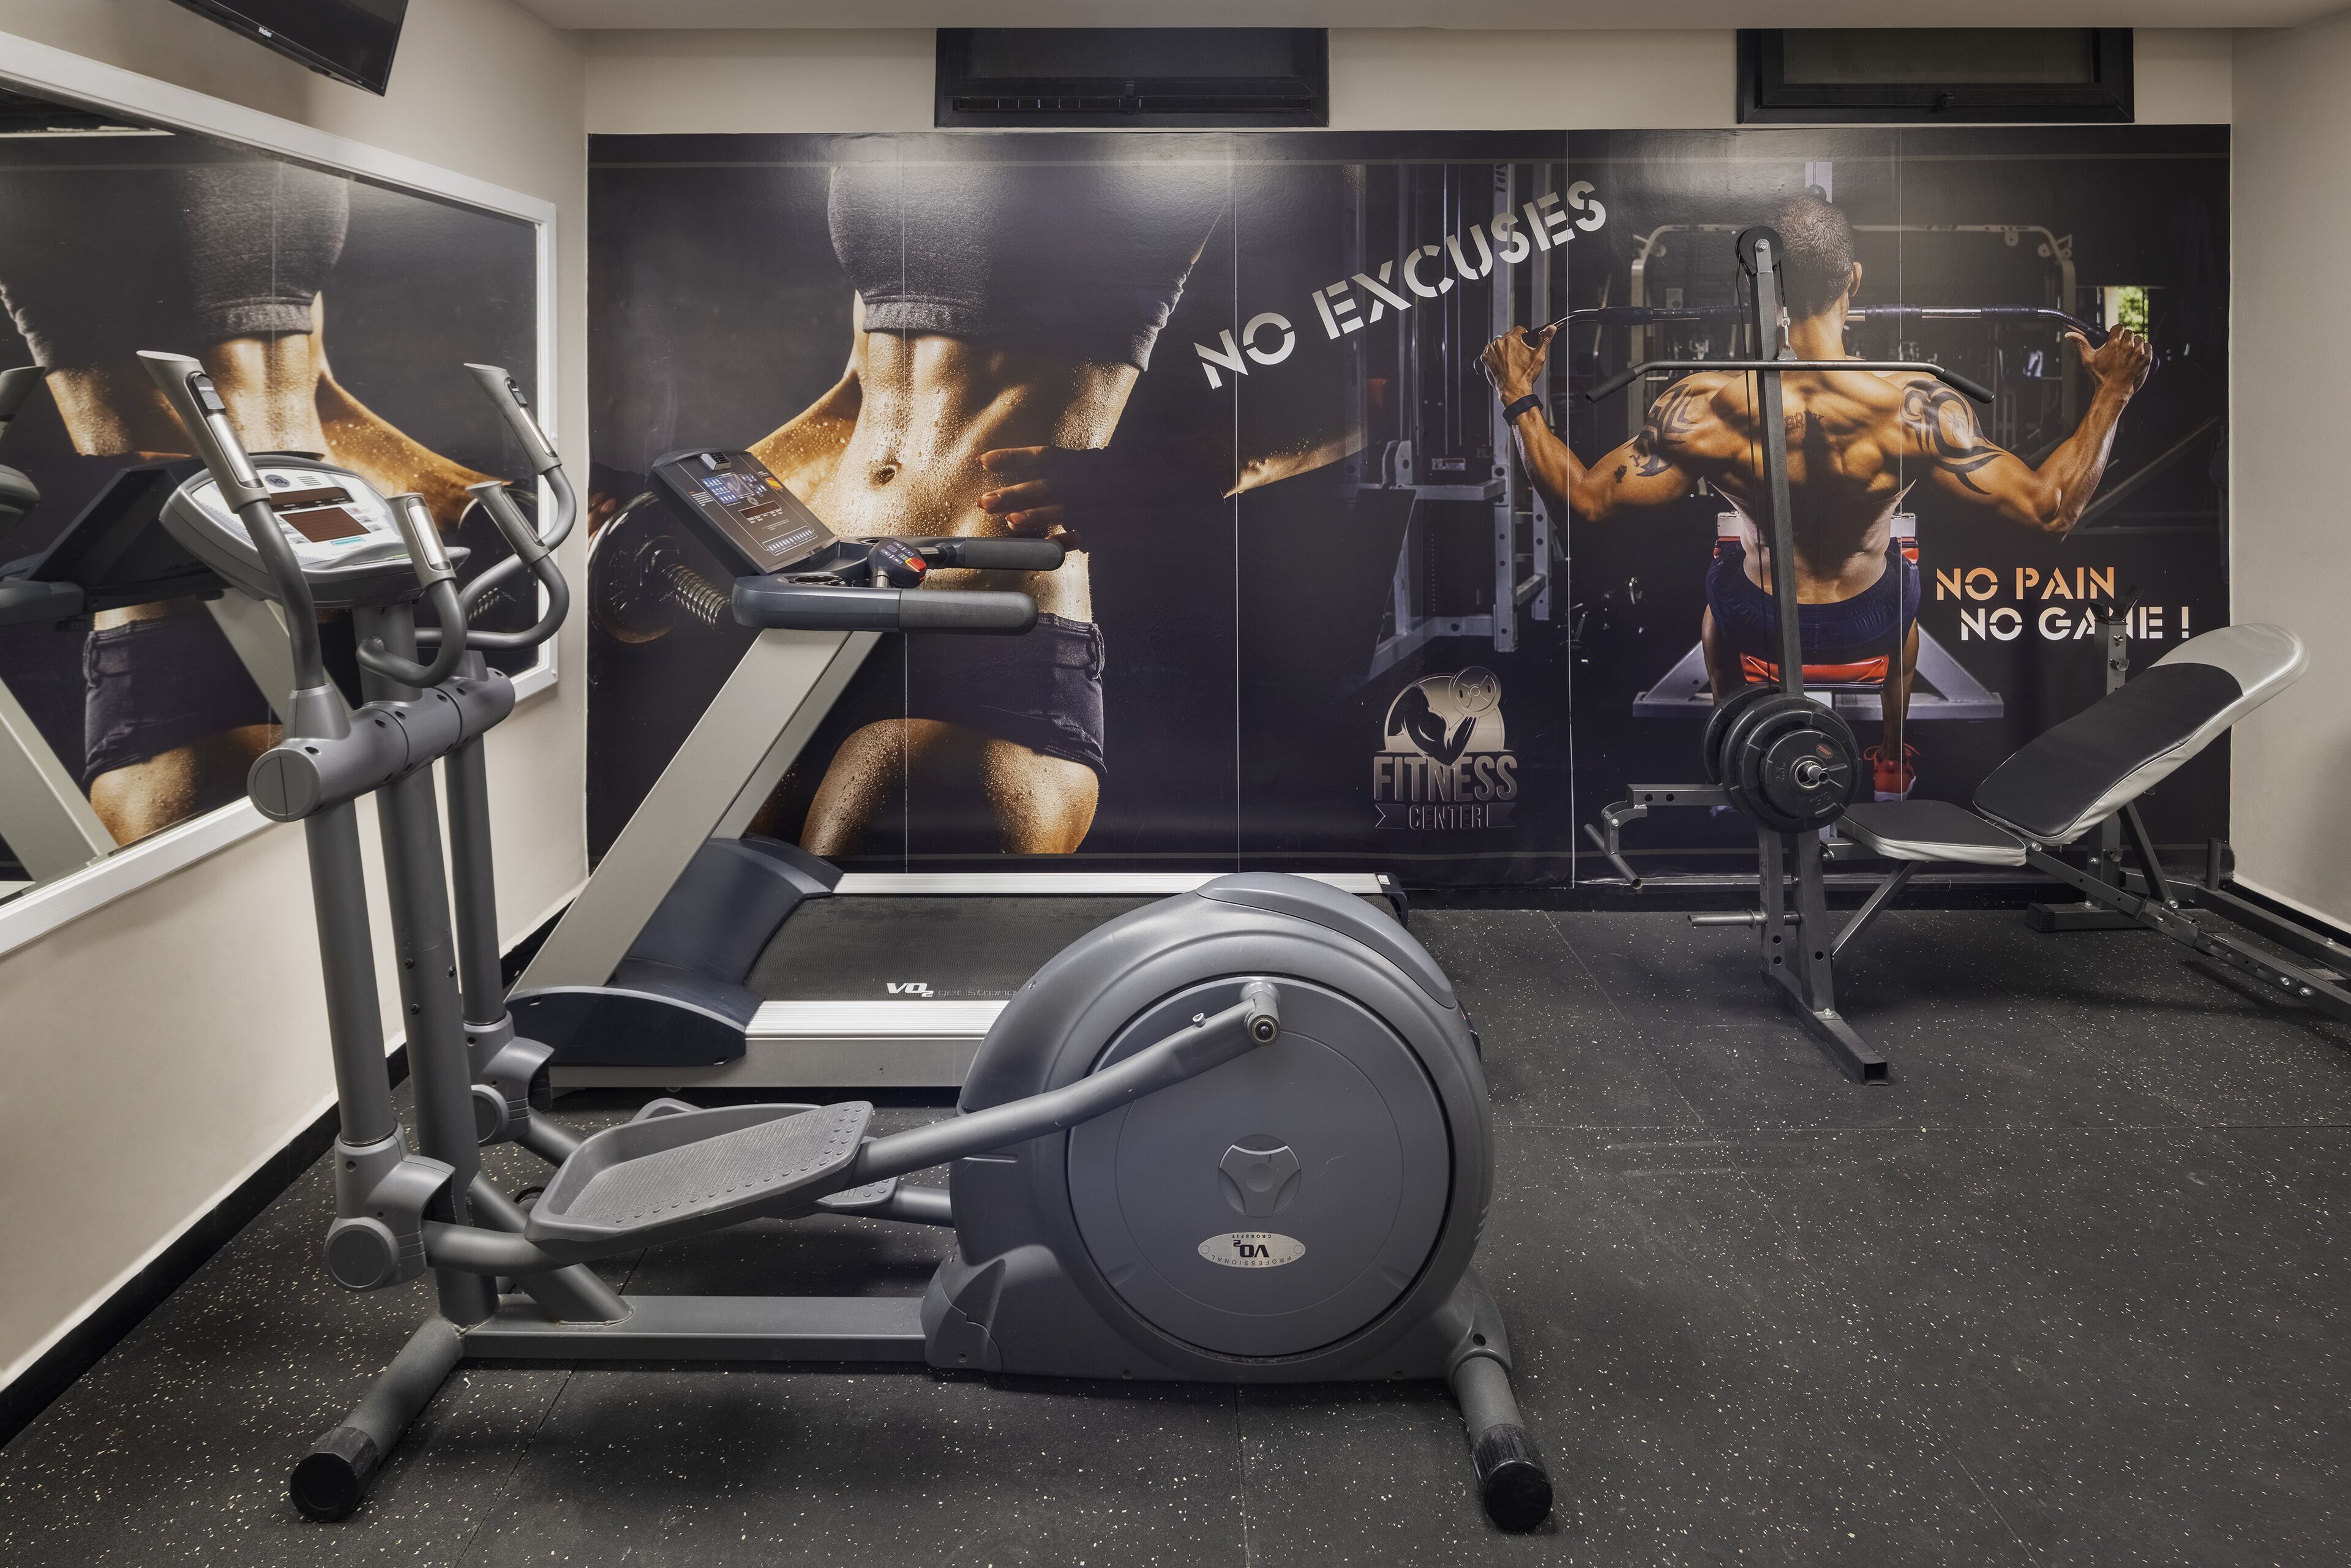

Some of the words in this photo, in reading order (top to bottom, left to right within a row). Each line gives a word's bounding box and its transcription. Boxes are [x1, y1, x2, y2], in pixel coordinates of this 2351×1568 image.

[1193, 312, 1295, 389] NO
[1311, 181, 1607, 340] EXCUSES
[1937, 567, 1998, 601] NO
[2015, 566, 2115, 600] PAIN
[1960, 607, 2022, 641] NO
[1373, 755, 1518, 802] FITNESS
[1409, 804, 1484, 830] CENTER
[1212, 1255, 1292, 1266] PROFESSIONAL
